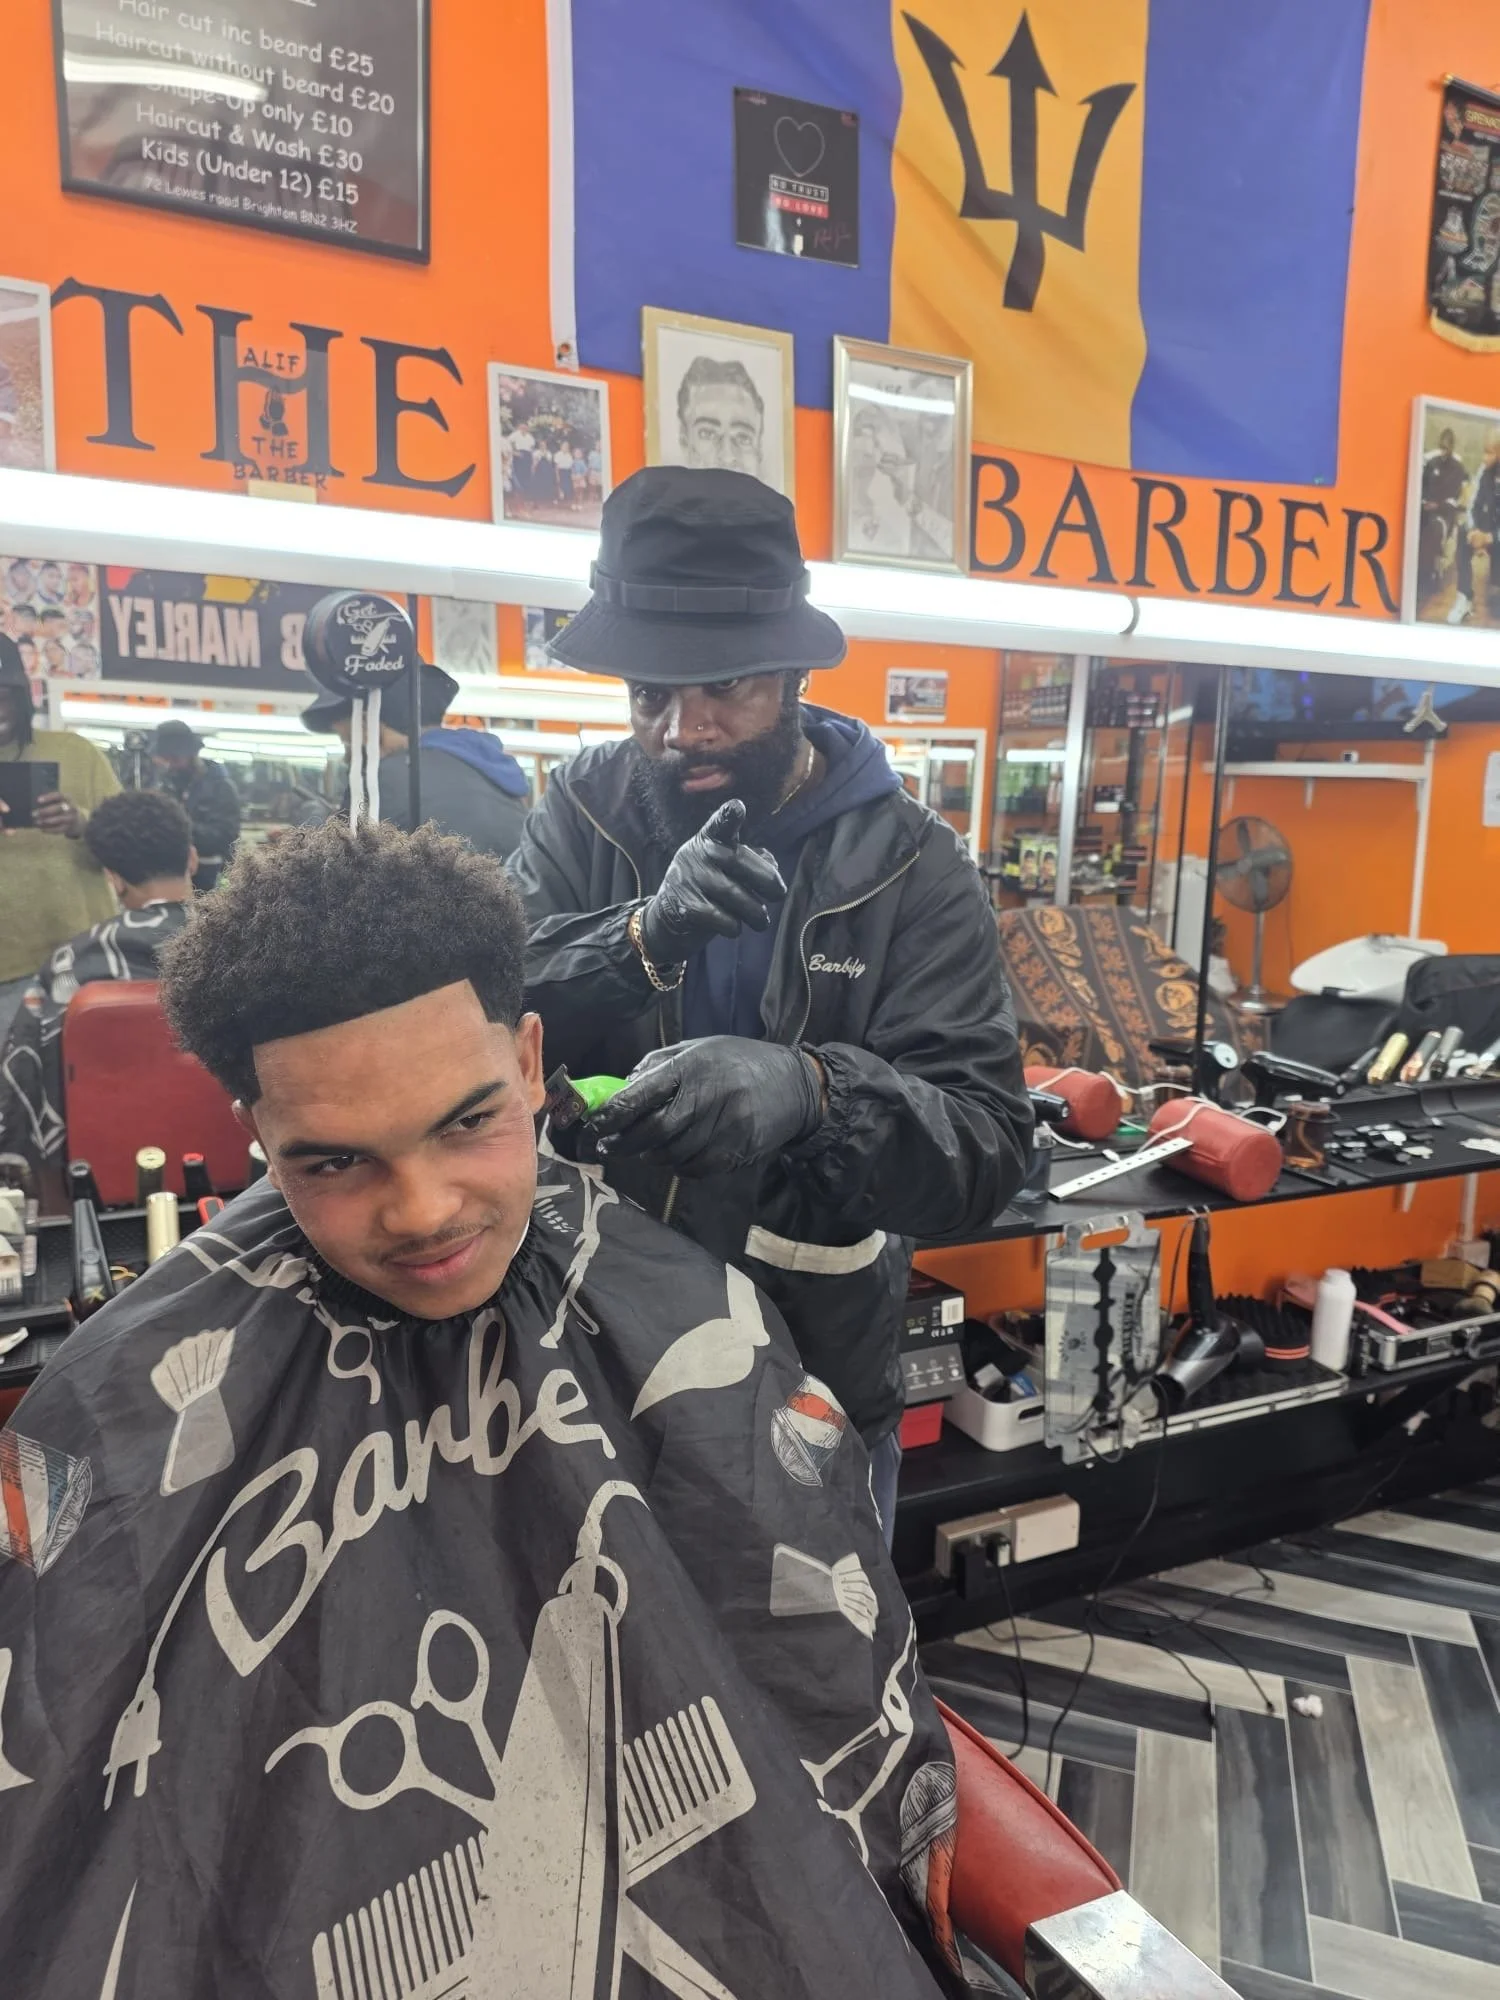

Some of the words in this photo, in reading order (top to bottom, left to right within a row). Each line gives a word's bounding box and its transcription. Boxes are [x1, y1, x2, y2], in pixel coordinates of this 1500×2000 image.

[119, 0, 170, 21] Hair
[178, 12, 213, 32] cut
[221, 18, 252, 45] inc
[260, 28, 322, 63] beard
[328, 46, 374, 76] £25
[95, 20, 183, 61] Haircut
[188, 49, 275, 85] without
[282, 68, 344, 103] beard
[350, 85, 394, 115] £20
[136, 101, 222, 140] Haircut
[229, 123, 245, 146] &
[252, 128, 311, 161] Wash
[318, 144, 363, 172] £30
[262, 103, 304, 132] only
[312, 110, 353, 137] £10
[142, 137, 189, 167] Kids
[196, 149, 272, 184] (Under
[280, 168, 311, 198] 12)
[317, 178, 359, 205] £15
[165, 182, 206, 201] Lewes
[208, 192, 239, 208] road
[243, 196, 298, 220] Brighton
[243, 347, 300, 372] ALIF
[50, 276, 476, 498] THE
[252, 436, 298, 459] THE
[234, 462, 328, 490] BARBER
[970, 454, 1399, 613] BARBER
[336, 600, 378, 625] Get
[344, 654, 404, 676] Faded
